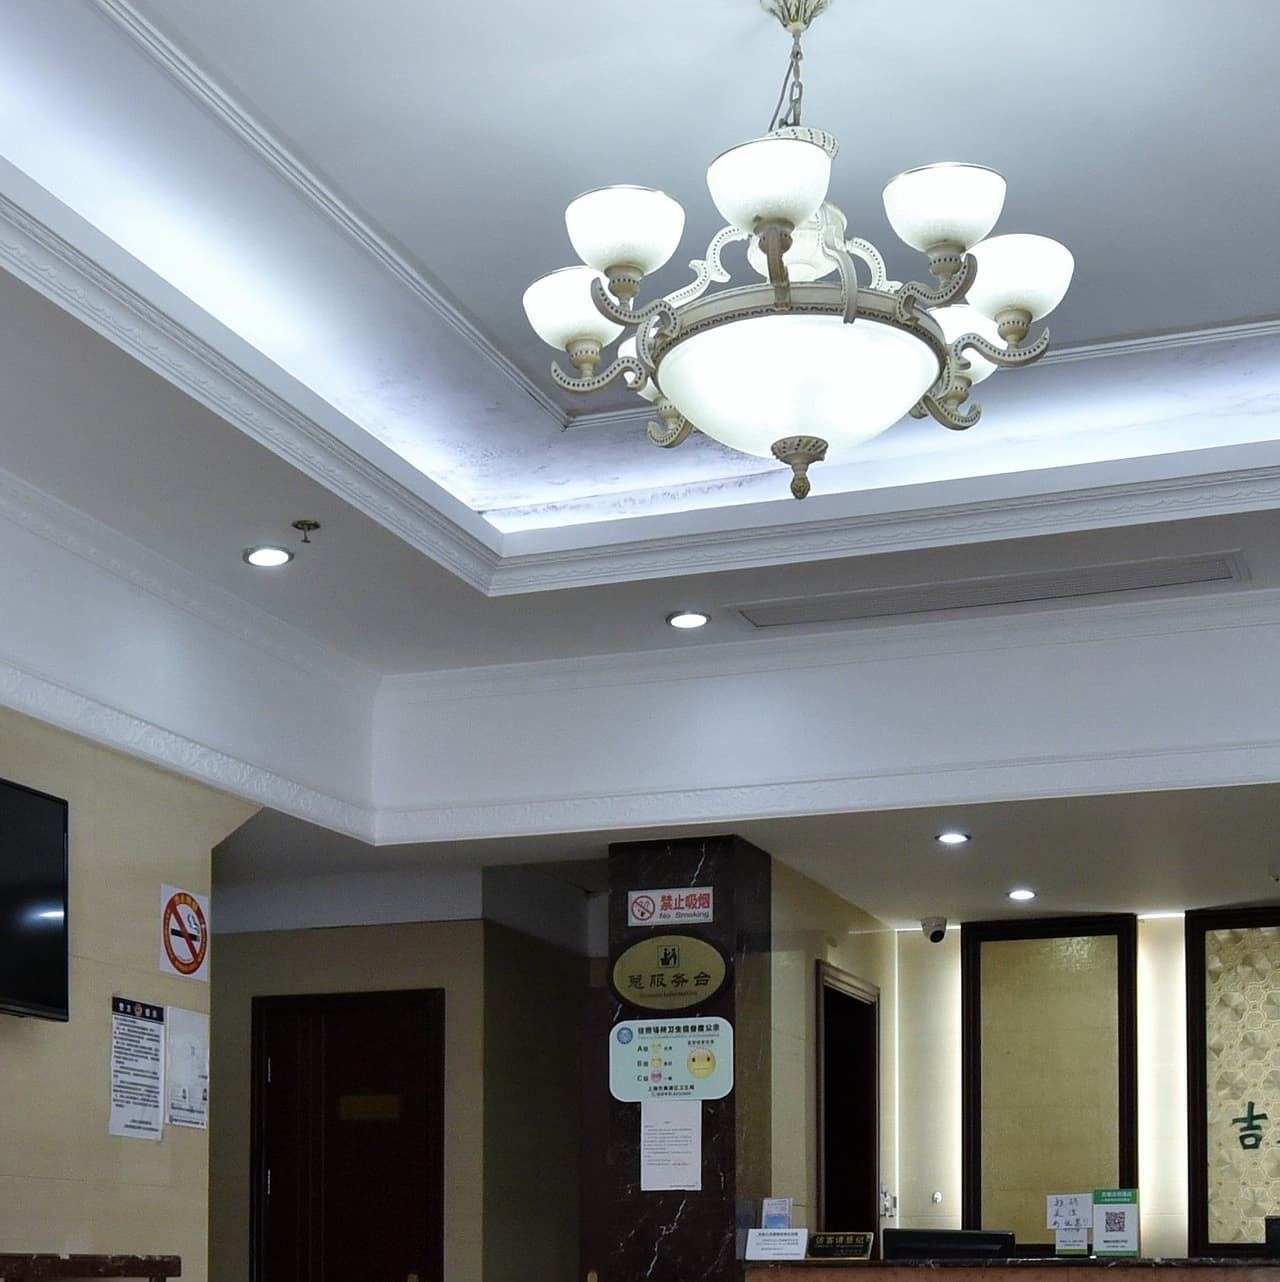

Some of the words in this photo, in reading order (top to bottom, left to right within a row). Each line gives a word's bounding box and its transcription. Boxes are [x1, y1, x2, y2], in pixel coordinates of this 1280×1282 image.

[660, 893, 710, 911] 禁止吸烟
[659, 912, 671, 920] No
[675, 910, 710, 921] Smoking
